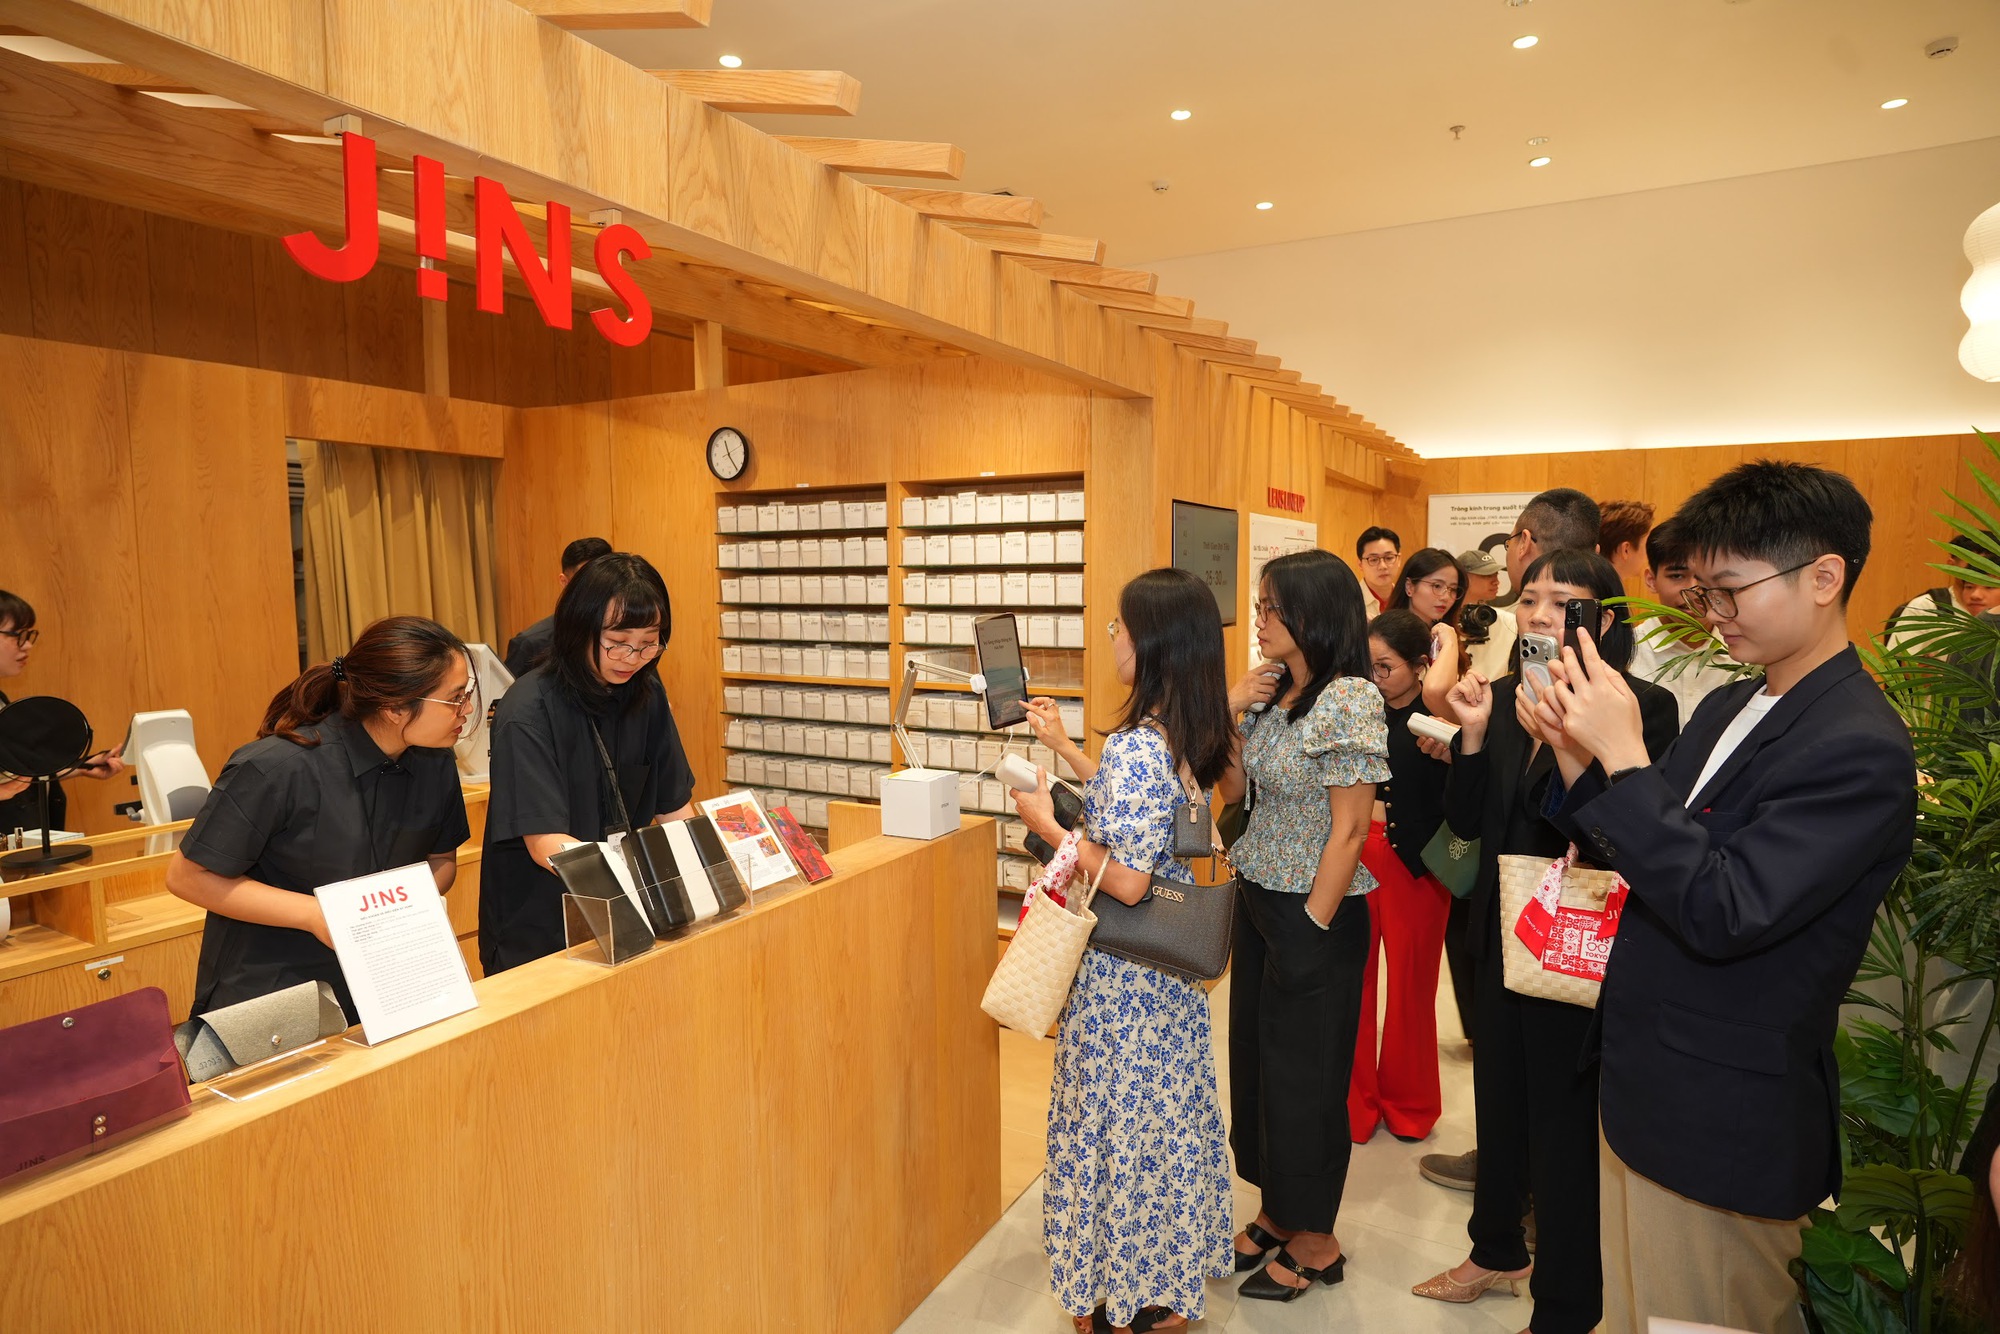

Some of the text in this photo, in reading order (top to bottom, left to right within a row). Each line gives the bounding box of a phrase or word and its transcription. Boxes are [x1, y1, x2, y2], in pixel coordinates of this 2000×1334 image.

[1152, 886, 1184, 902] GUESS
[1536, 928, 1544, 937] Life
[1585, 951, 1608, 961] TOKYO
